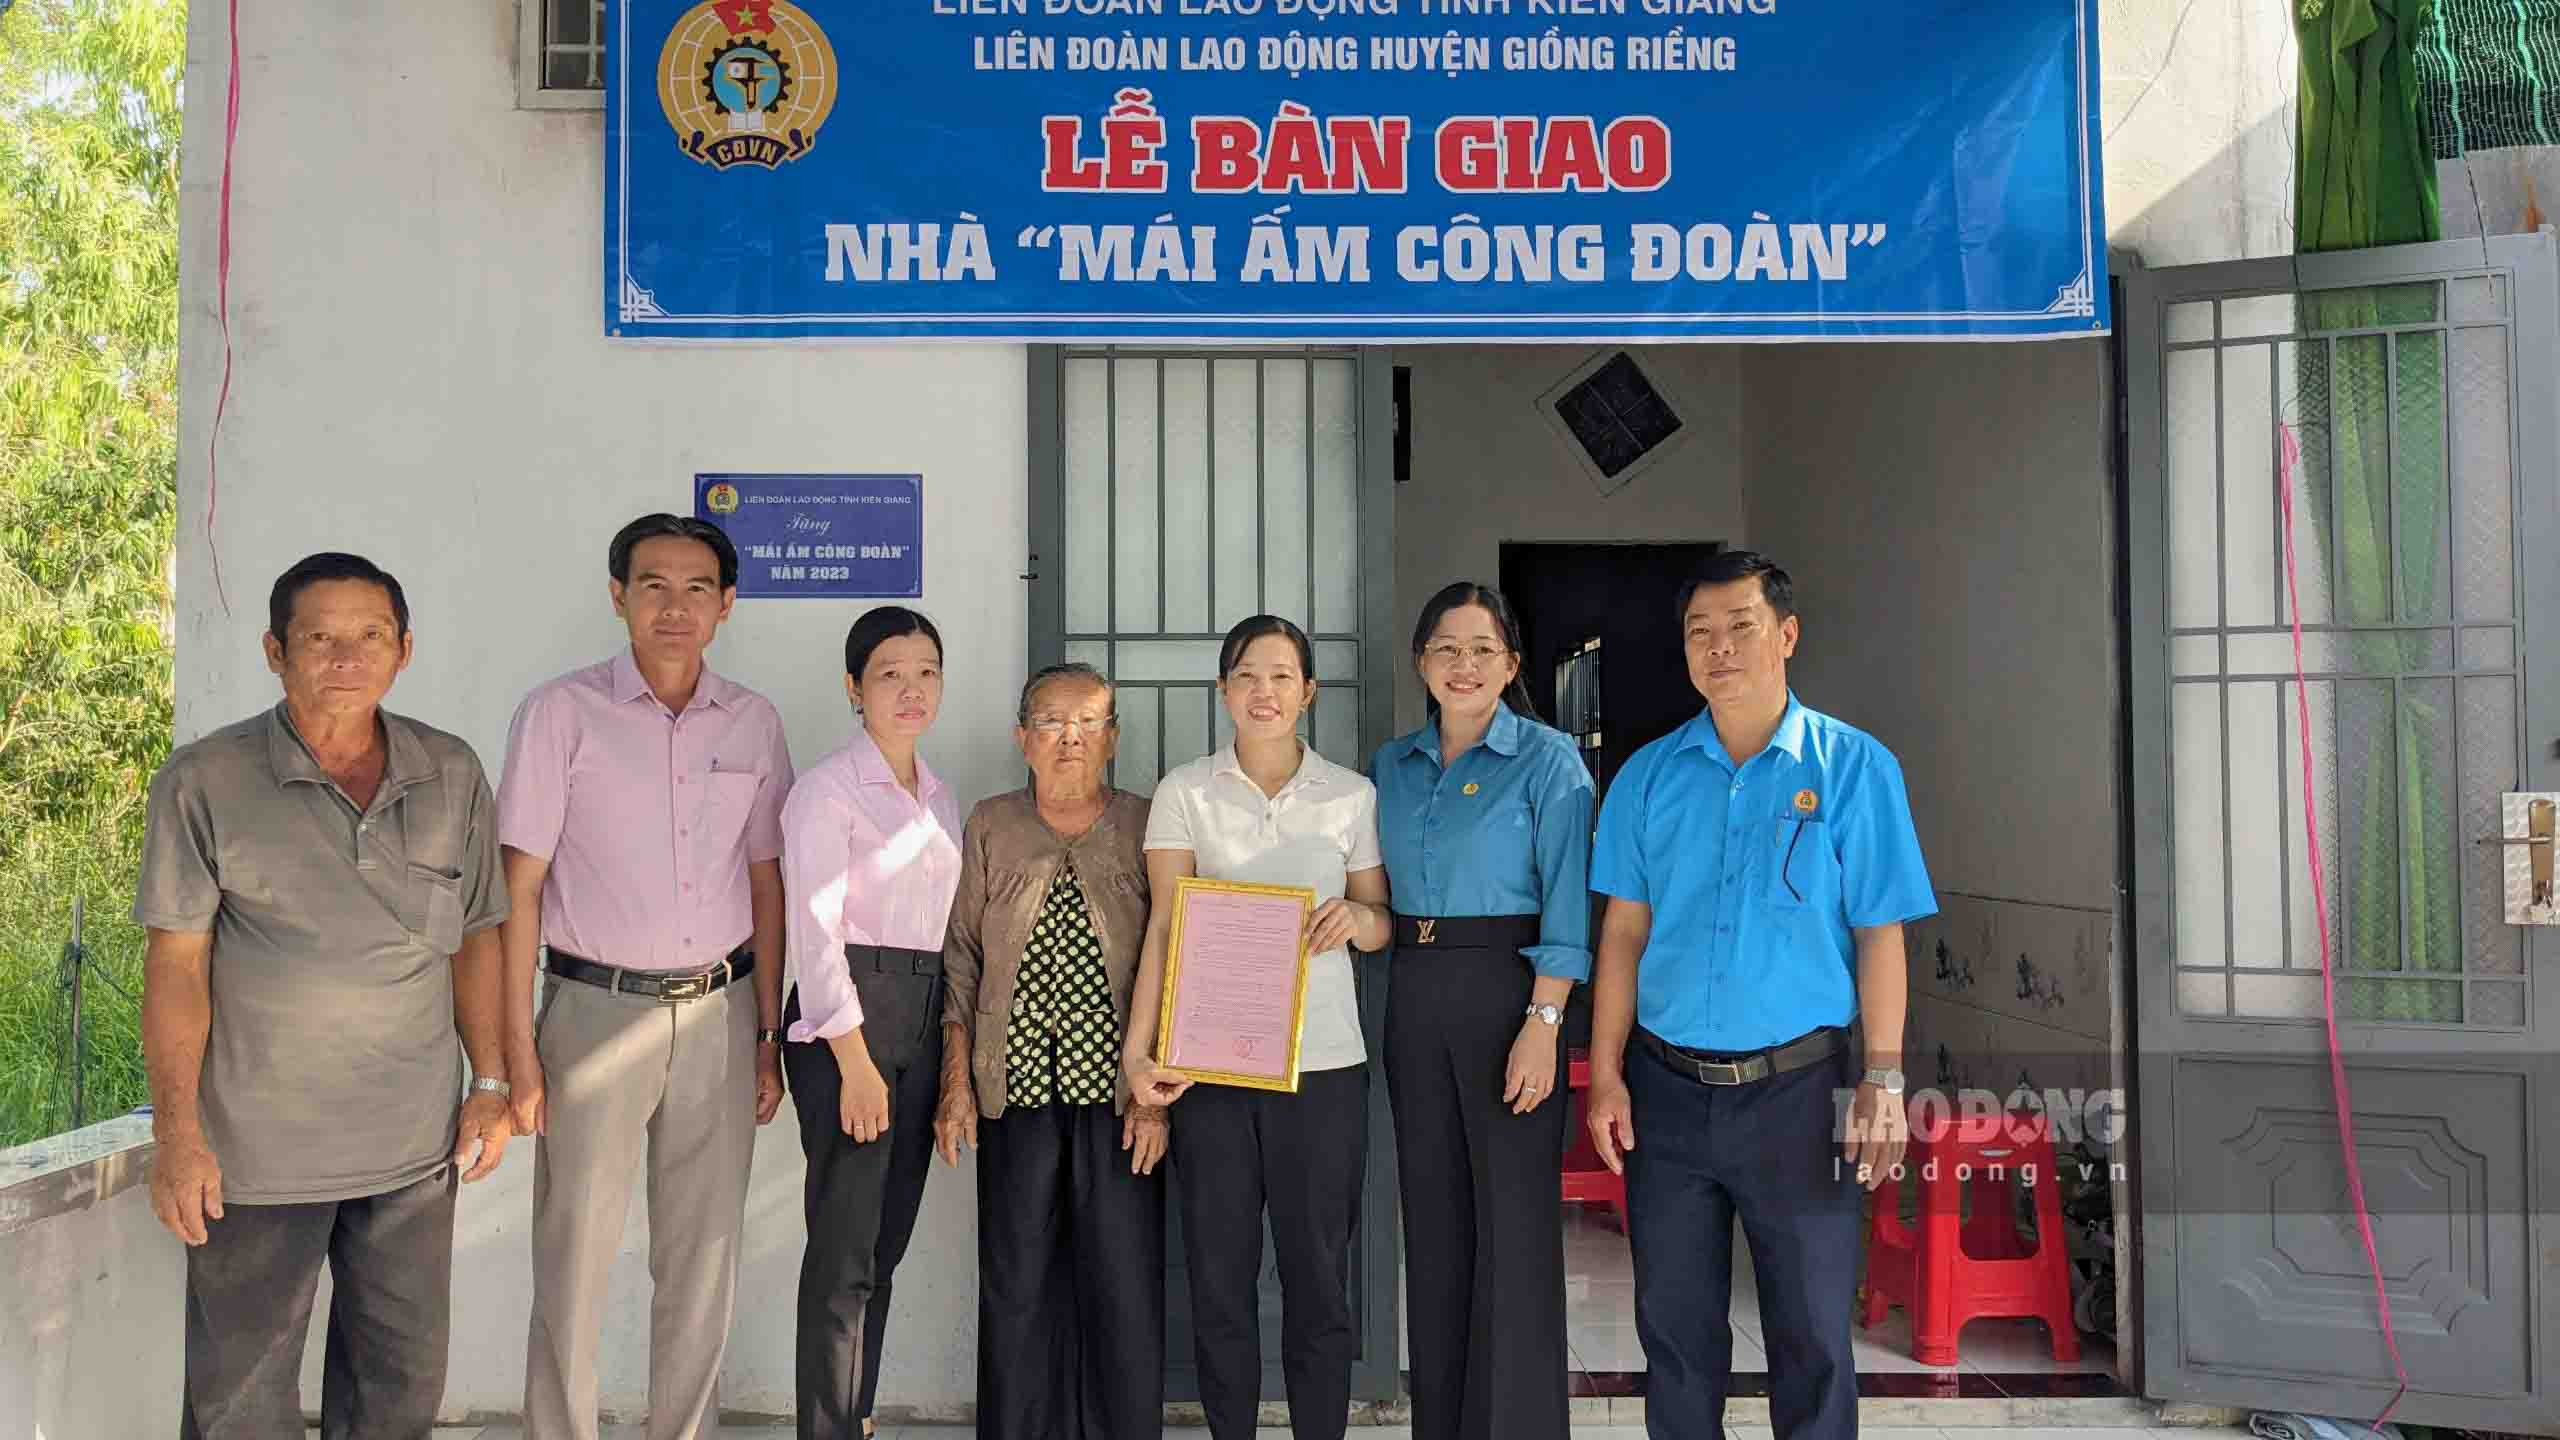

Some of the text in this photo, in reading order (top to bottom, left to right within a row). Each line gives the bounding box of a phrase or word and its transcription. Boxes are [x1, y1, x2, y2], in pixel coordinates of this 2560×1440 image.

[974, 26, 1737, 78] LIÊN ĐOÀN LAO ĐỘNG HUYỆN GIỒNG RIỀNG
[1041, 87, 1673, 195] LỄ BÀN GIAO
[825, 211, 996, 282] NHÀ
[1240, 204, 1371, 282] ẤM
[1396, 213, 1606, 282] CÔNG
[809, 566, 849, 580] 2023
